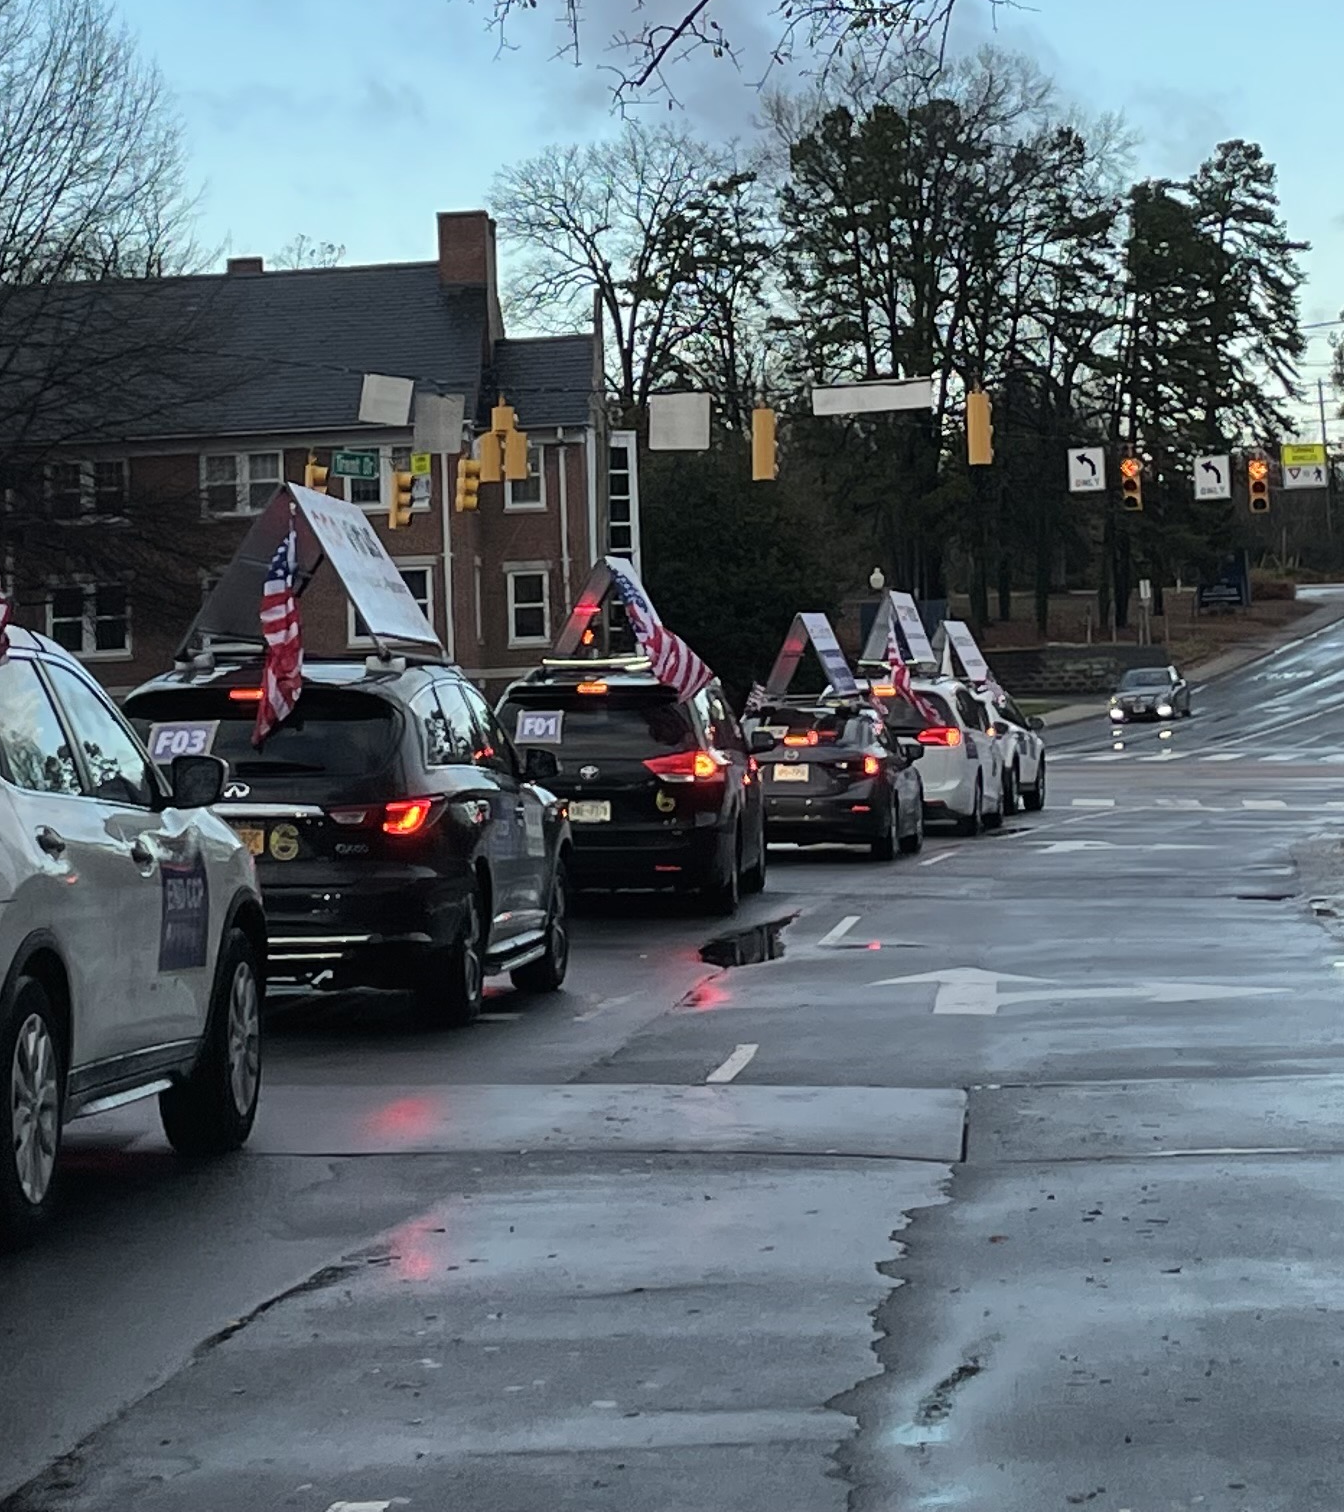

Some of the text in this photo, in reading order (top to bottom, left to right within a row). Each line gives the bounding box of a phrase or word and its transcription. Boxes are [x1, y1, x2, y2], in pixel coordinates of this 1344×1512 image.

[1075, 477, 1100, 488] ONLY
[1200, 485, 1225, 496] ONLY
[522, 717, 557, 737] F01
[154, 729, 207, 755] F03
